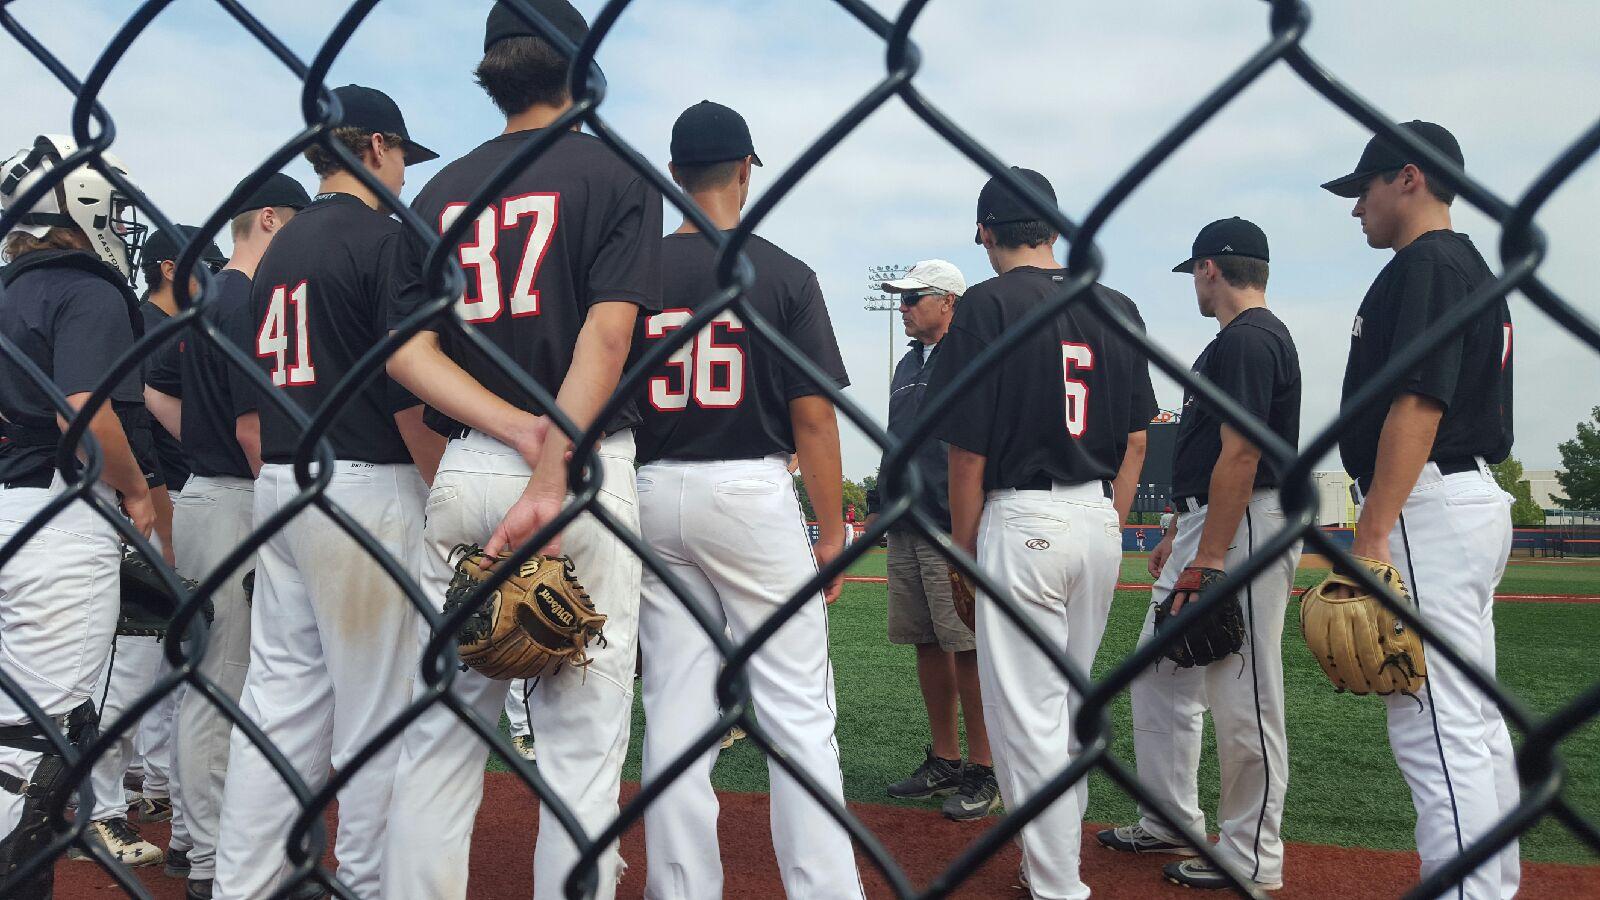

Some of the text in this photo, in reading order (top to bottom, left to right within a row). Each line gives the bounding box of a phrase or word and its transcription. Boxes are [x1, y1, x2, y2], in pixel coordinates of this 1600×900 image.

[441, 192, 560, 324] 37
[256, 280, 316, 387] 41
[645, 308, 745, 411] 36
[1061, 341, 1094, 438] 6
[538, 588, 573, 625] Wilson
